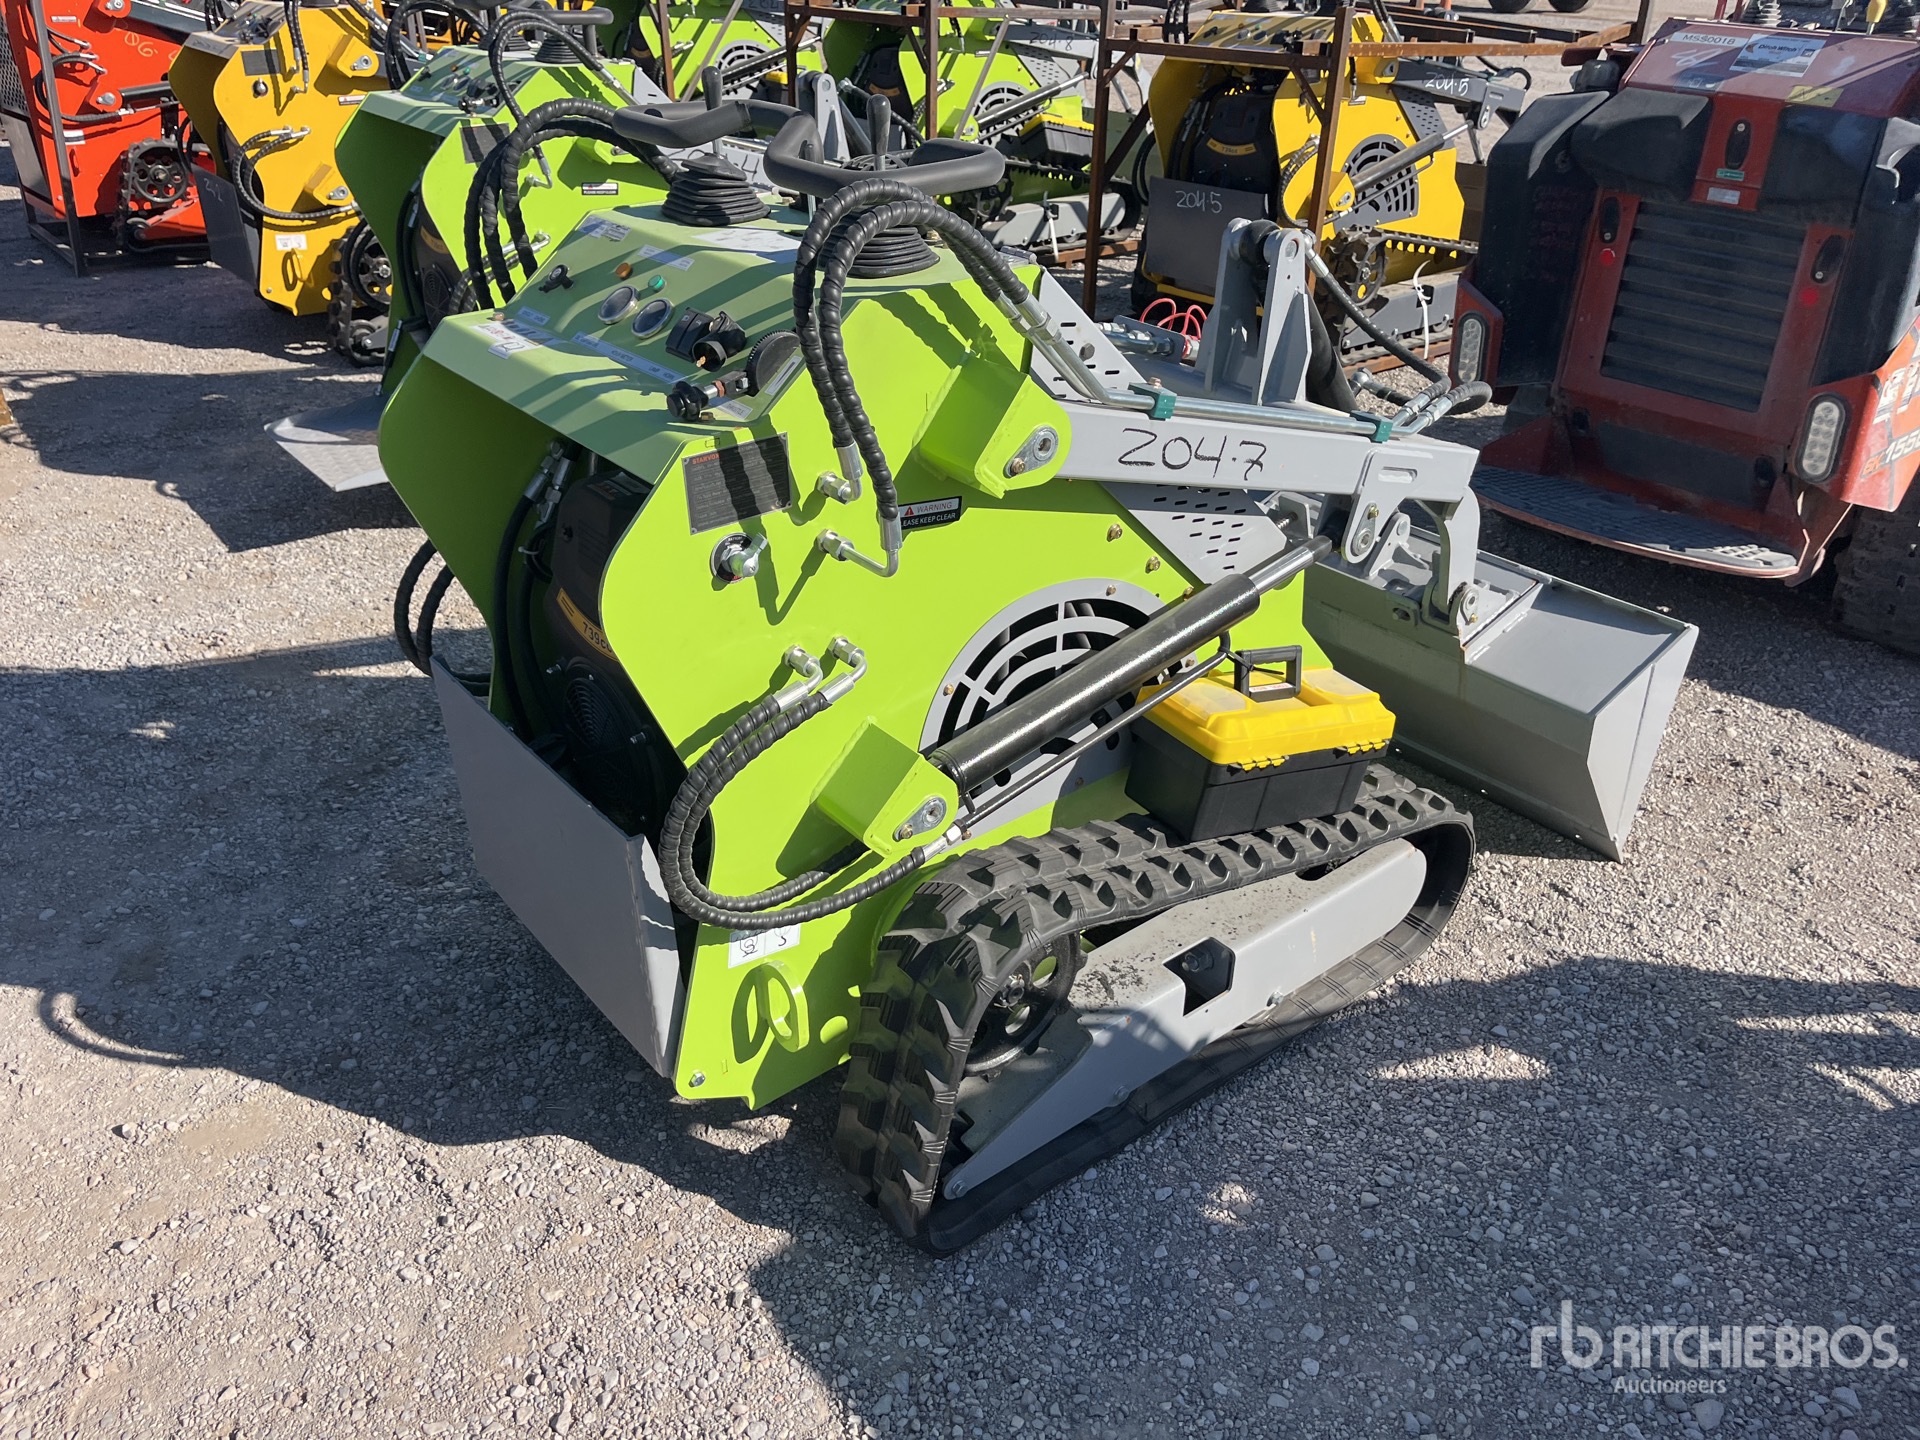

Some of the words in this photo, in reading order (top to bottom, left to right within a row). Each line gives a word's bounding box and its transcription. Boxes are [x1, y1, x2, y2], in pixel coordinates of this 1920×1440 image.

[917, 501, 953, 514] WARNING
[902, 516, 920, 527] EASE
[920, 515, 936, 525] KEEP
[936, 512, 956, 522] CLEAR
